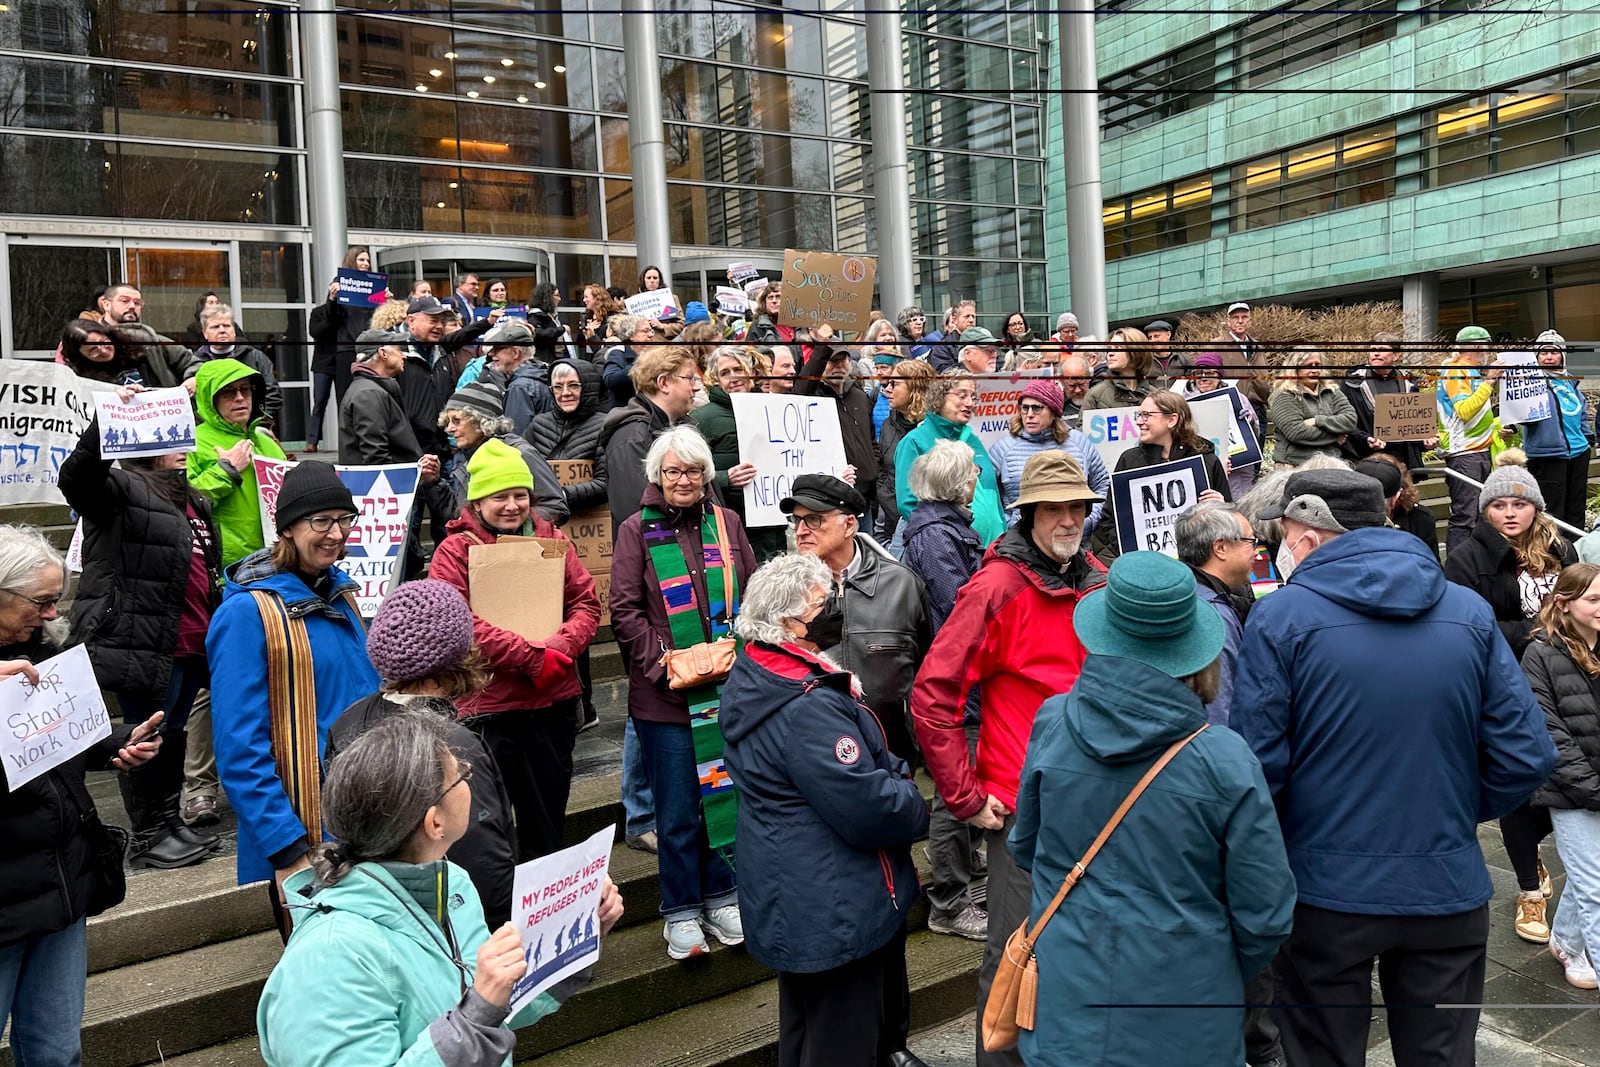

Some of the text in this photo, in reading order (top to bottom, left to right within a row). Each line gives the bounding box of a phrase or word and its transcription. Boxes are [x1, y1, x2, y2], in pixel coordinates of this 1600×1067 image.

[787, 258, 840, 288] Save
[819, 287, 858, 302] Our
[783, 297, 857, 326] Neighbors
[0, 383, 57, 406] ISH
[102, 398, 185, 414] MY PEOPLE WERE
[110, 408, 182, 422] REFUGEES TOO
[976, 404, 1018, 416] WELCO
[1389, 408, 1432, 419] WELCOMES
[765, 403, 821, 442] LOVE
[1376, 424, 1430, 437] THE REFUGEE
[781, 449, 805, 468] THY
[1141, 479, 1187, 514] NO
[360, 497, 399, 516] בית
[570, 524, 605, 539] LOVE
[7, 692, 77, 739] Start
[521, 855, 607, 910] MY PEOPLE WERE
[527, 878, 599, 928] REFUGEES TOO
